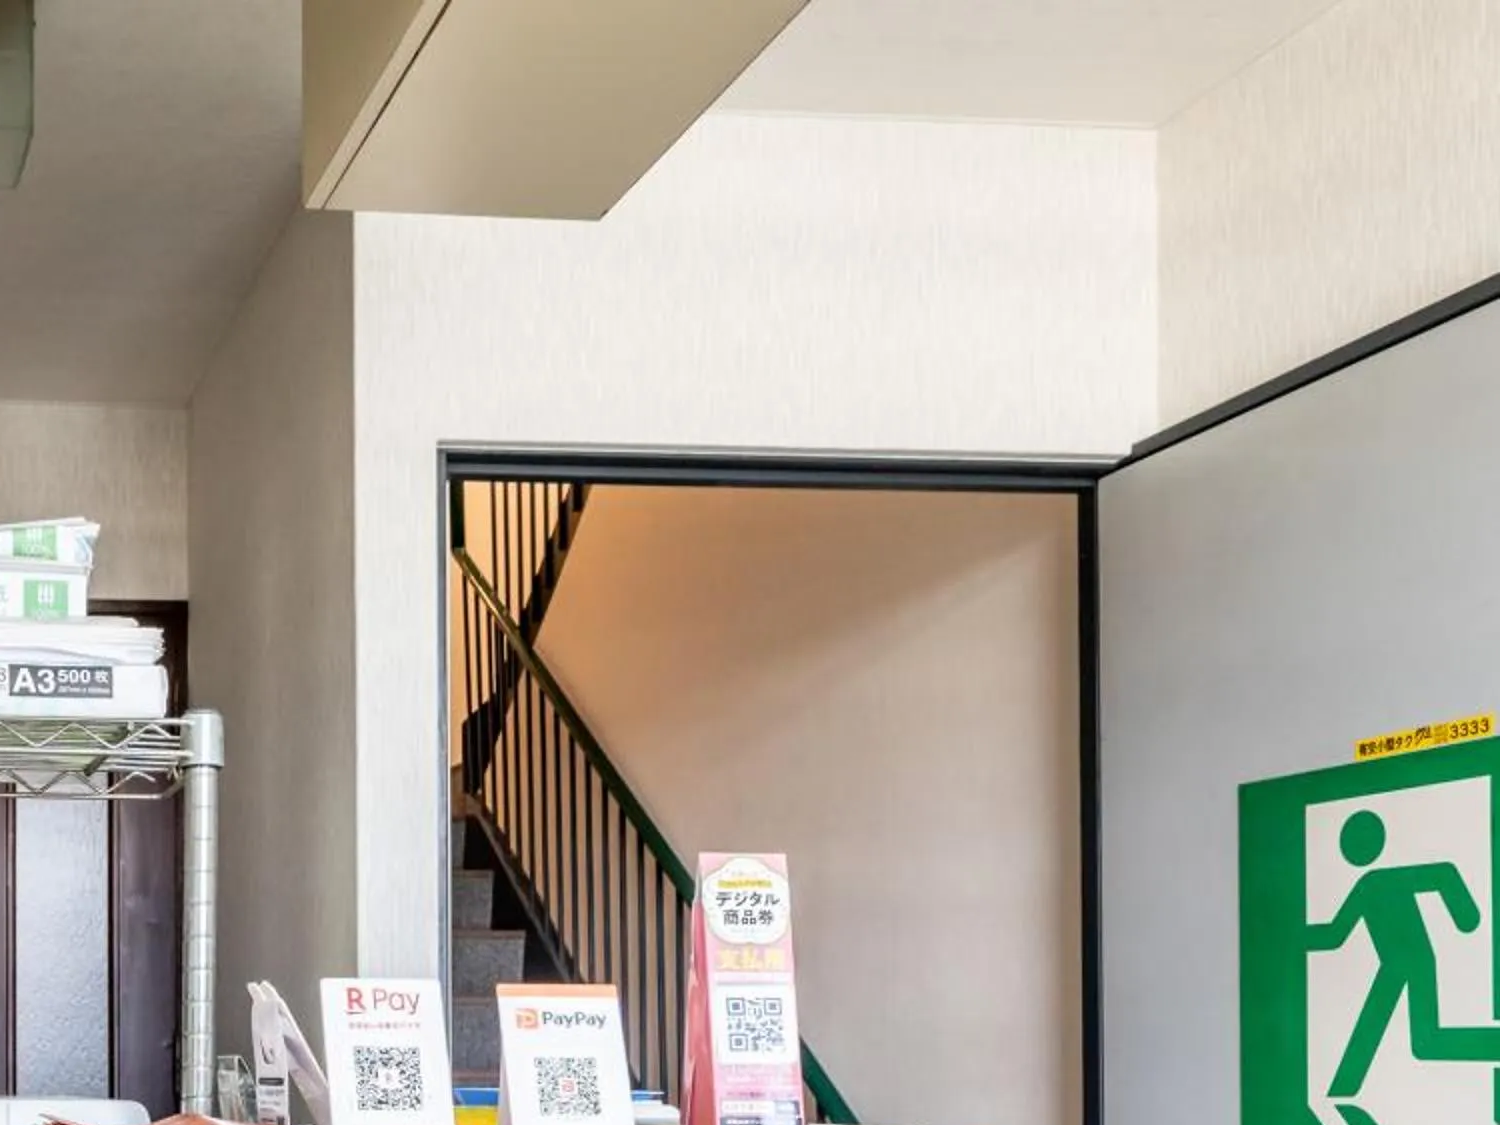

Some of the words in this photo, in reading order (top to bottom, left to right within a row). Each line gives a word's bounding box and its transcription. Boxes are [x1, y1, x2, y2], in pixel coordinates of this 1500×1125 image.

[12, 667, 56, 694] A3
[57, 669, 91, 683] 500
[1449, 717, 1489, 739] 3333
[716, 891, 780, 906] デジタル
[723, 909, 773, 926] 商品券
[372, 987, 420, 1015] Pay
[542, 1011, 607, 1029] PayPay
